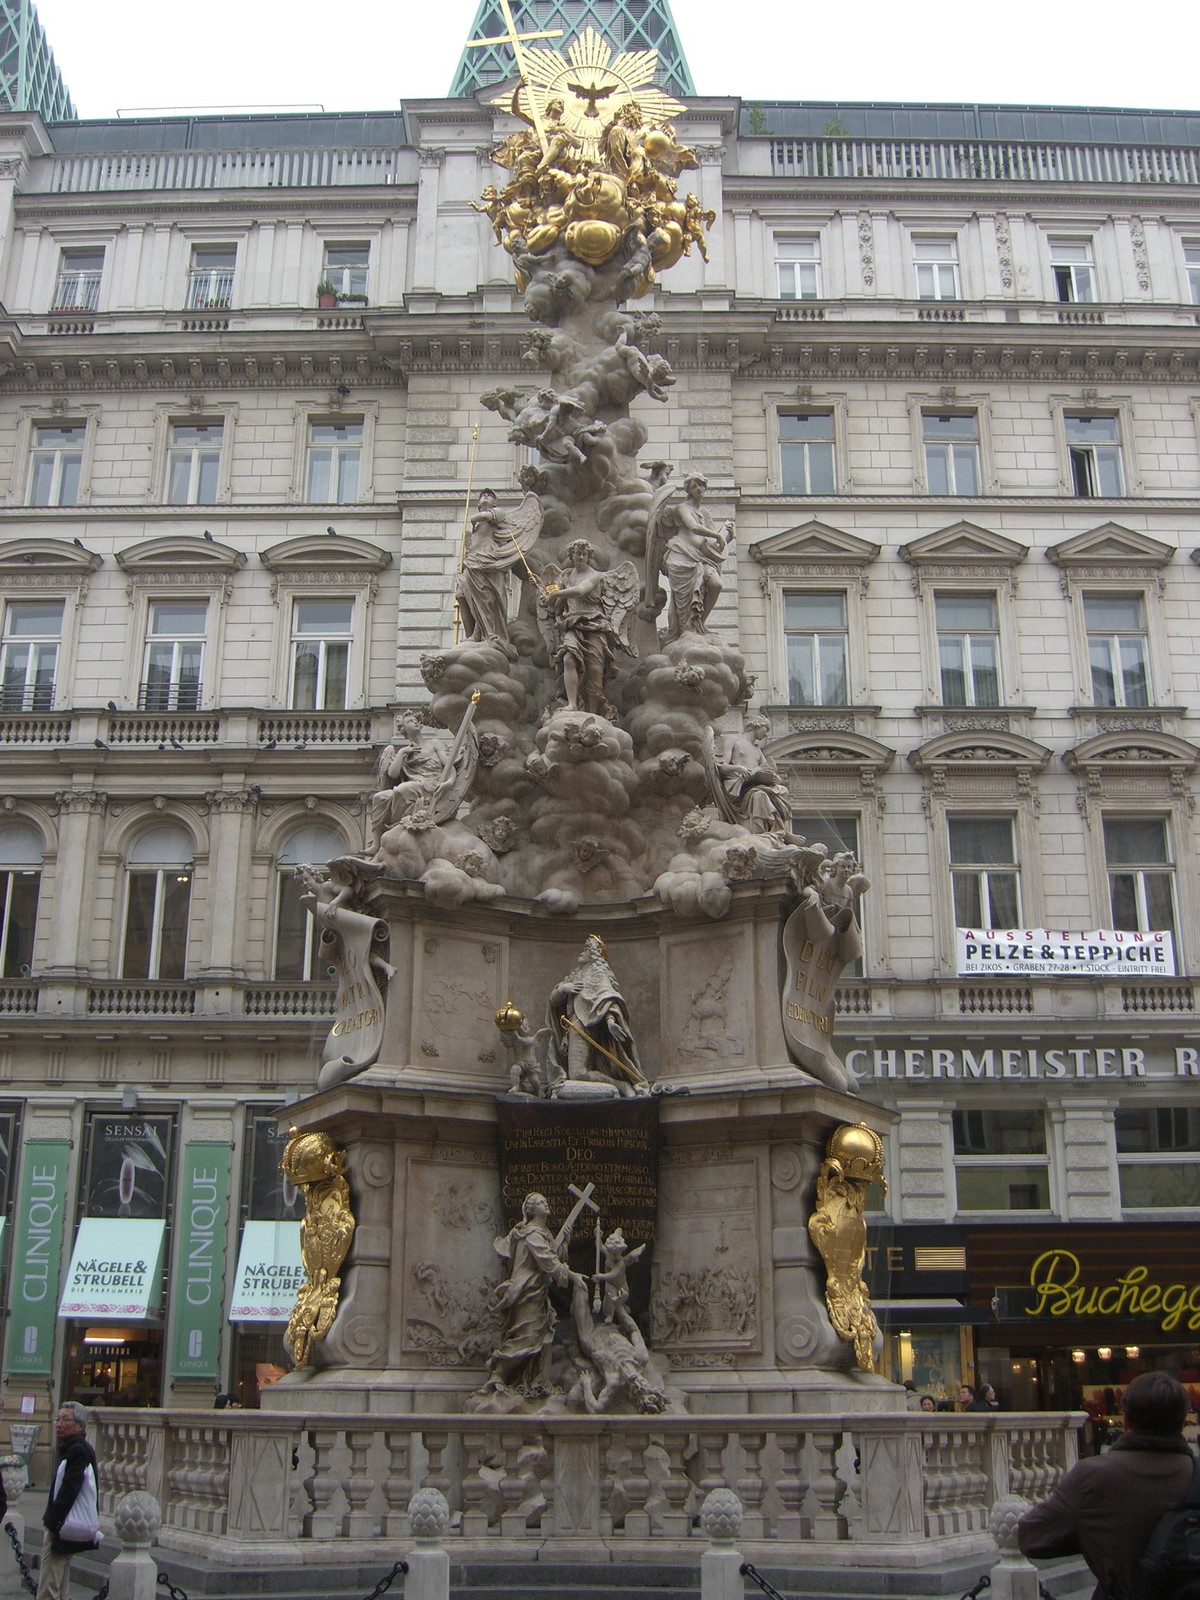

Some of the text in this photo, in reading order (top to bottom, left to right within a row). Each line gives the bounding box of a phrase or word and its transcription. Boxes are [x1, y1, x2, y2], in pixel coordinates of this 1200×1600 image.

[965, 930, 1163, 943] AUSSTELLUNG
[966, 944, 1165, 962] PELZE & TEPPICHE
[965, 963, 978, 971] BEI
[980, 963, 1003, 971] ZIKOS
[1013, 963, 1045, 972] GRABEN
[1048, 963, 1070, 972] 27-28
[1117, 965, 1148, 973] EINTRITT
[1151, 966, 1167, 974] FREI
[104, 1125, 157, 1137] SENSAI
[22, 1165, 58, 1302] CLINIQUE
[186, 1167, 220, 1305] CLINIQUE
[73, 1274, 144, 1287] STRUBELL
[243, 1278, 305, 1290] STRUBE
